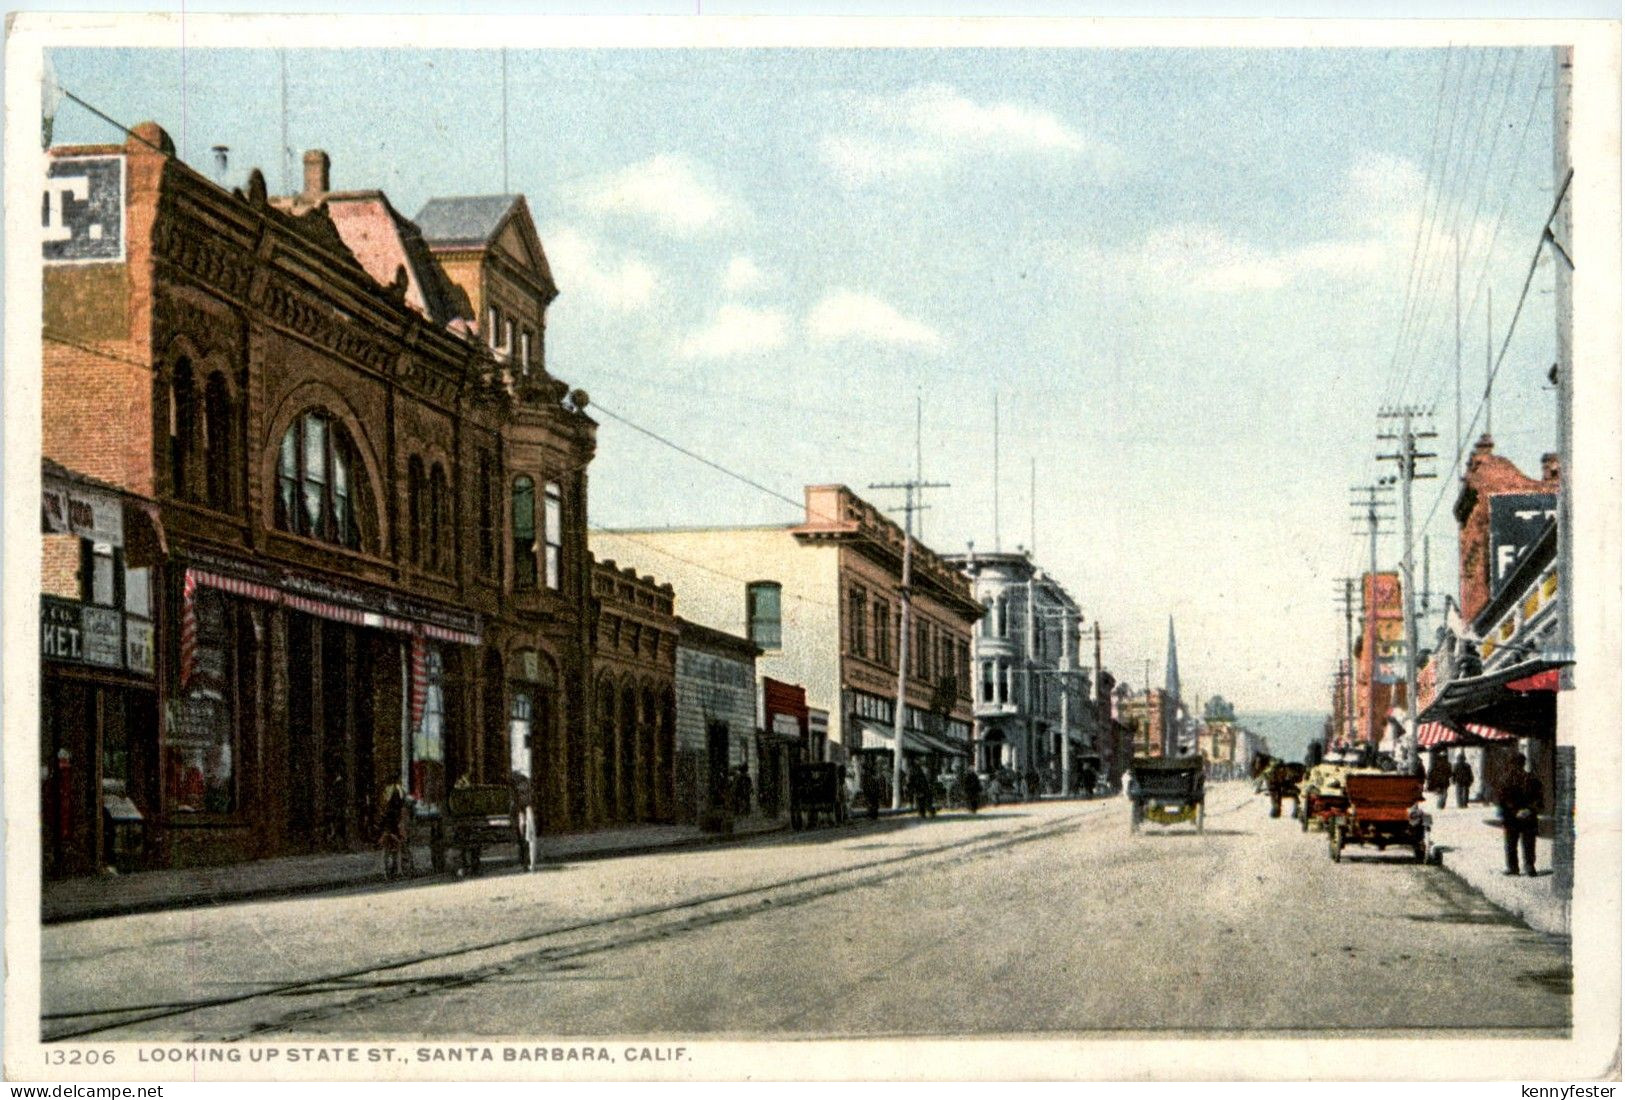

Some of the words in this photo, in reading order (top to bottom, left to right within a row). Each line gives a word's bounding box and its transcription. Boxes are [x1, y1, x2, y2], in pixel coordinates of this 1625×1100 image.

[43, 1050, 116, 1065] 13206
[139, 1048, 241, 1062] LOOKING
[249, 1048, 279, 1062] UP
[286, 1048, 359, 1062] STATE
[367, 1048, 408, 1064] ST.,
[416, 1047, 493, 1062] SANTA
[503, 1047, 615, 1063] BARBARA,
[624, 1047, 692, 1062] CALIF.
